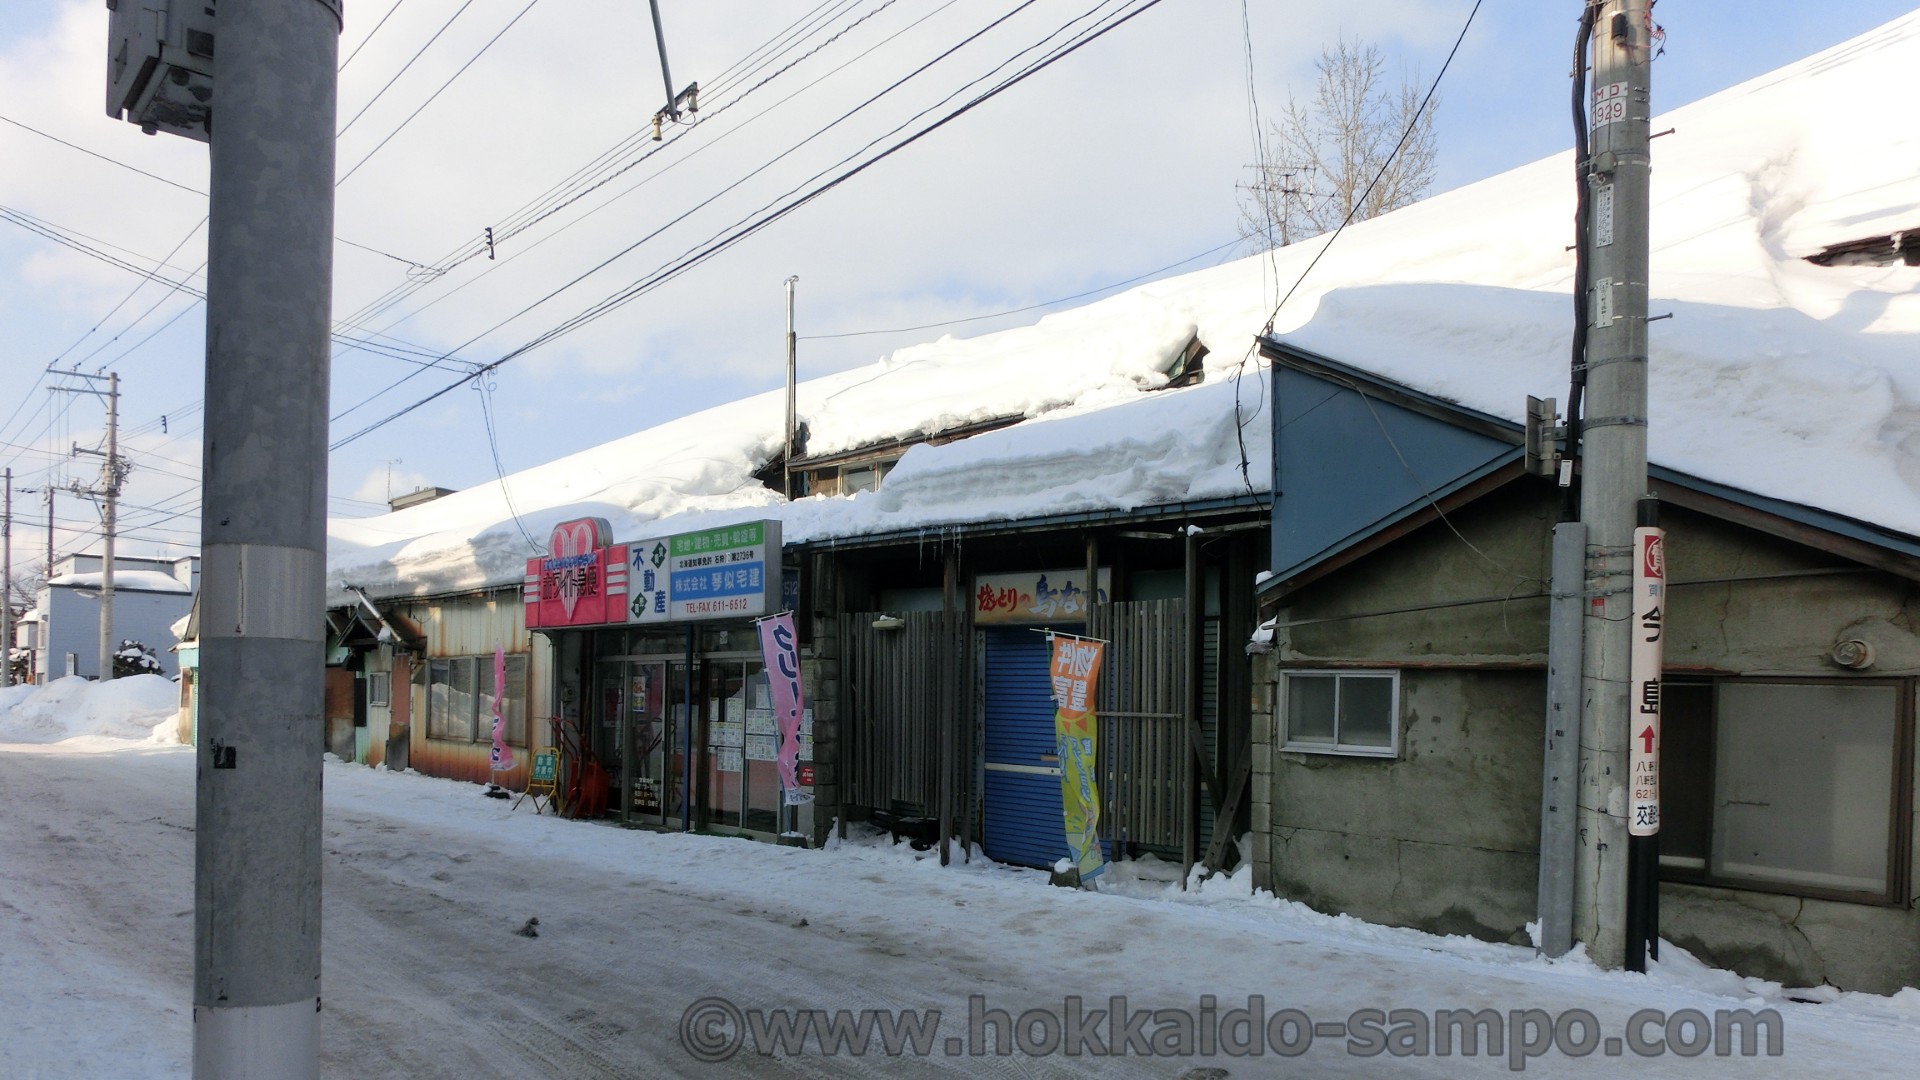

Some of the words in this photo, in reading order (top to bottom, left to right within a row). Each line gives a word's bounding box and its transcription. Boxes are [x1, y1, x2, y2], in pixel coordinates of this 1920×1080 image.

[633, 548, 665, 613] 不動産
[675, 575, 708, 592] 株式会社
[711, 567, 760, 591] 琴似宅建
[713, 598, 747, 612] 611-6512
